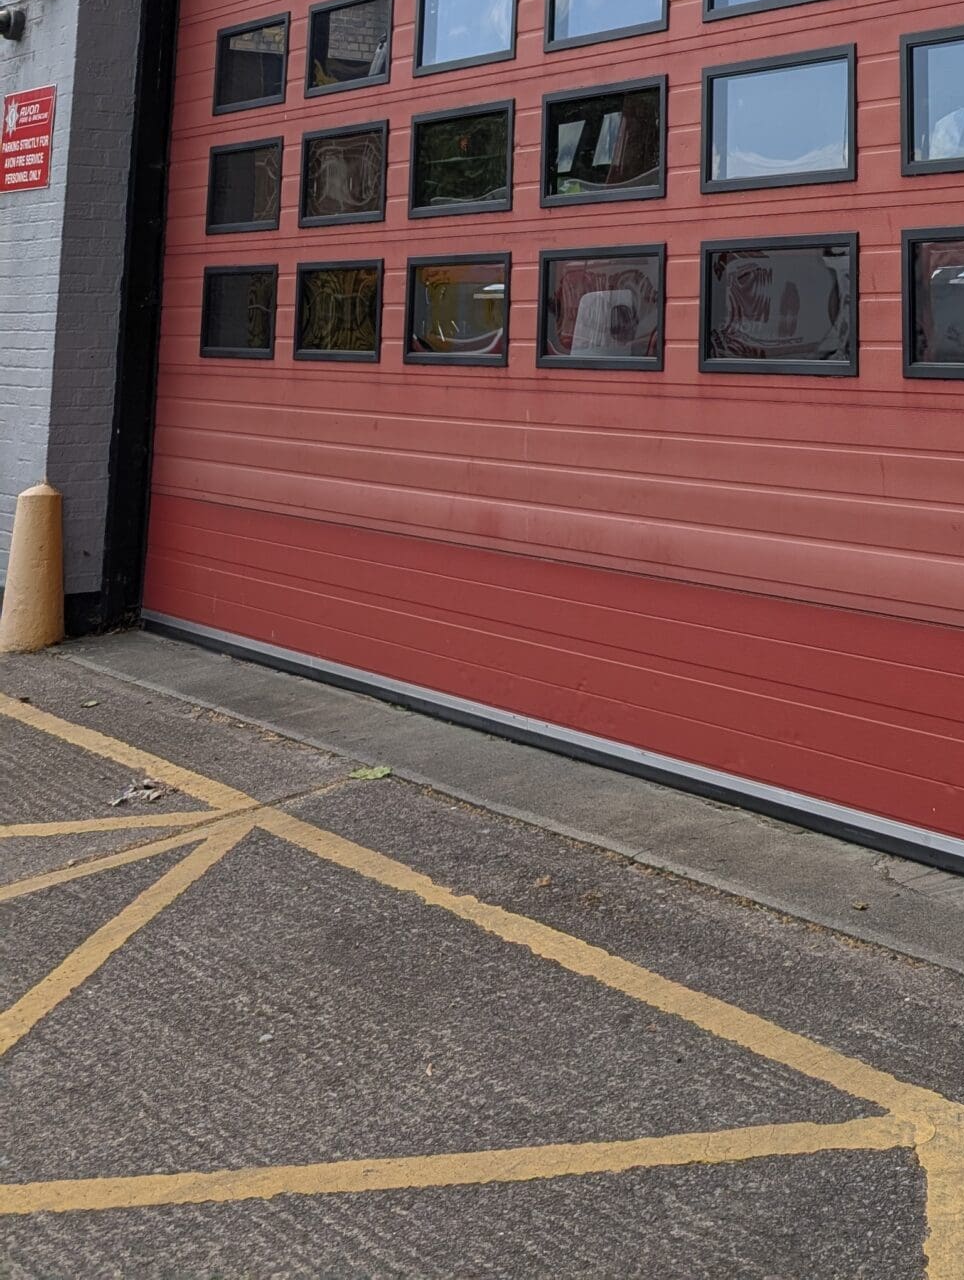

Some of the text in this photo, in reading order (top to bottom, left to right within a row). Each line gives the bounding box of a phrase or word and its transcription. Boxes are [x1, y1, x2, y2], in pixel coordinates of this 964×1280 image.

[20, 104, 40, 117] AVON
[2, 135, 49, 153] PARKING STRICTLY FOR
[4, 152, 44, 169] AVON FIRE SERVICE
[5, 169, 41, 185] PERSONNEL ONLY
